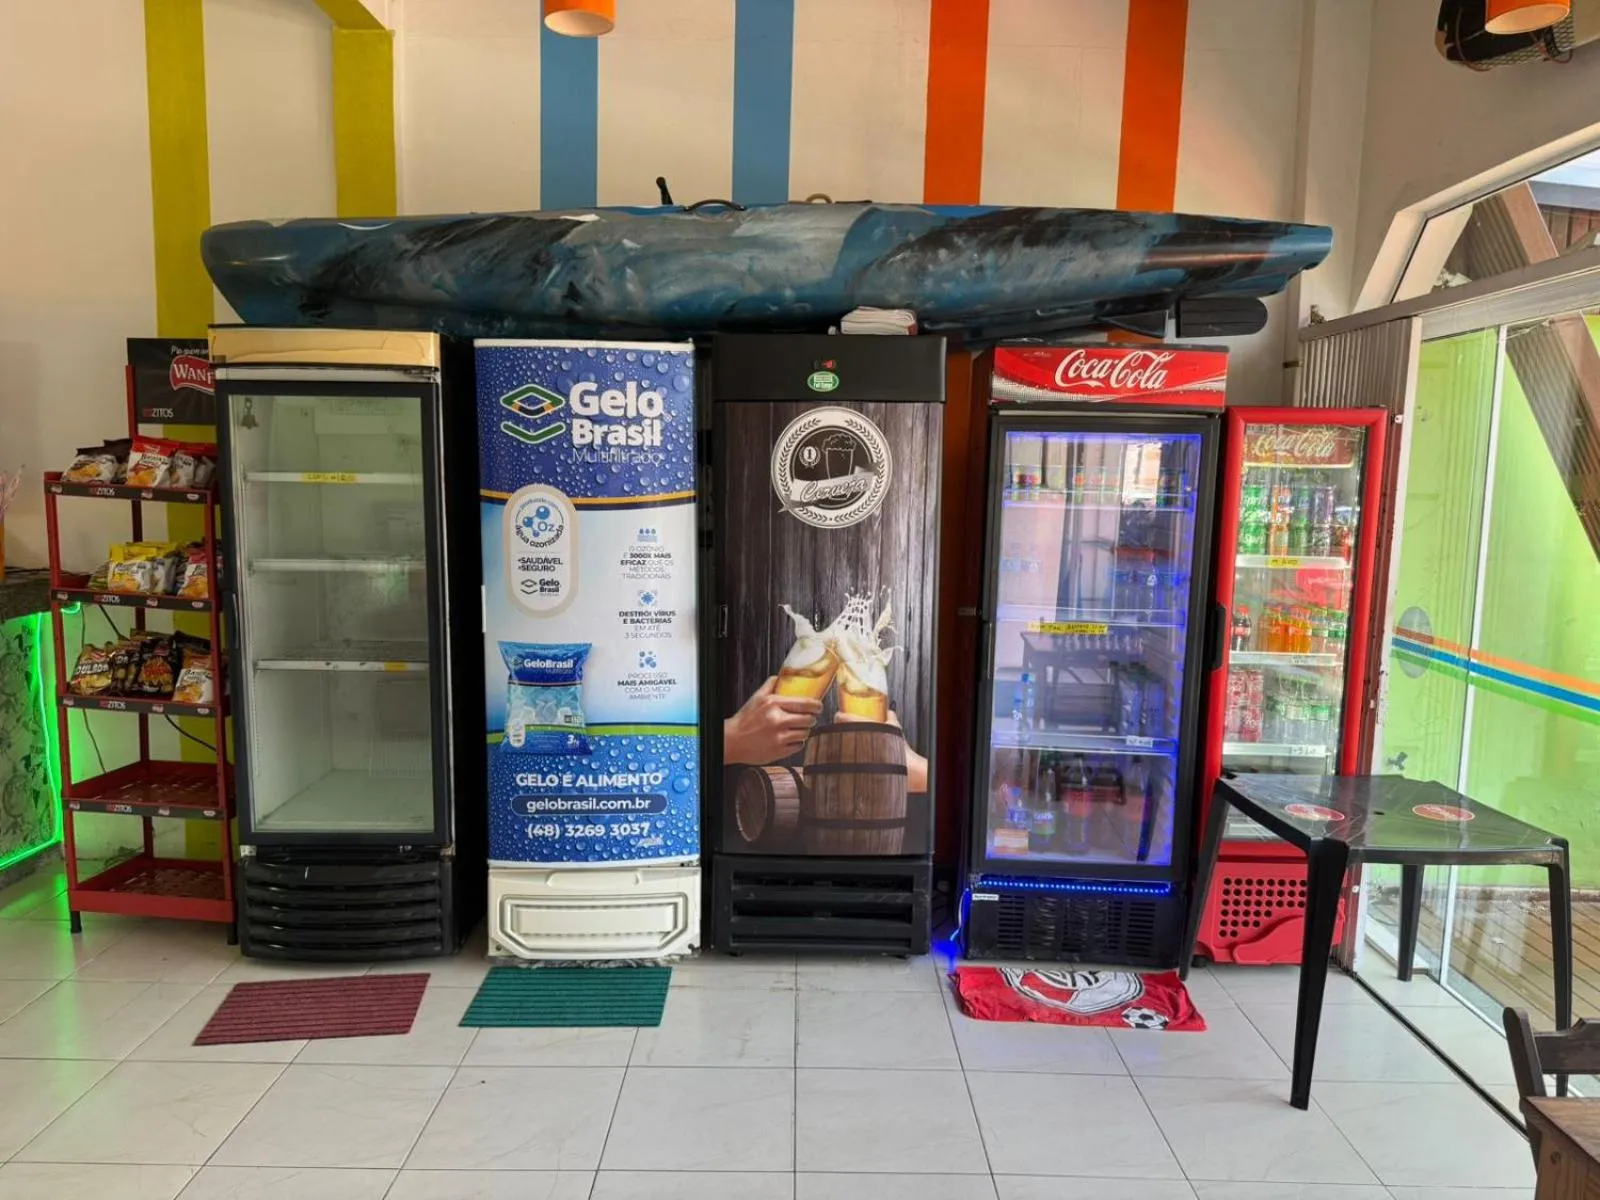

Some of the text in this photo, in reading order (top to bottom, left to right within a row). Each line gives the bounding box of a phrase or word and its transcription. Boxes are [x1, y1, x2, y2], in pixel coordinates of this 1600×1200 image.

[1055, 349, 1175, 389] Coca-Cola
[569, 381, 664, 418] Gelo
[572, 418, 662, 447] Brasil
[520, 556, 564, 565] SAUDÁVEL
[521, 564, 556, 572] SEGURO
[539, 578, 560, 587] Gelo
[523, 658, 574, 669] GeloBrasil
[516, 771, 663, 787] GELO É ALIMENTO
[526, 796, 651, 812] gelobrasil.com.br
[527, 822, 650, 838] (48) 3269 3037
